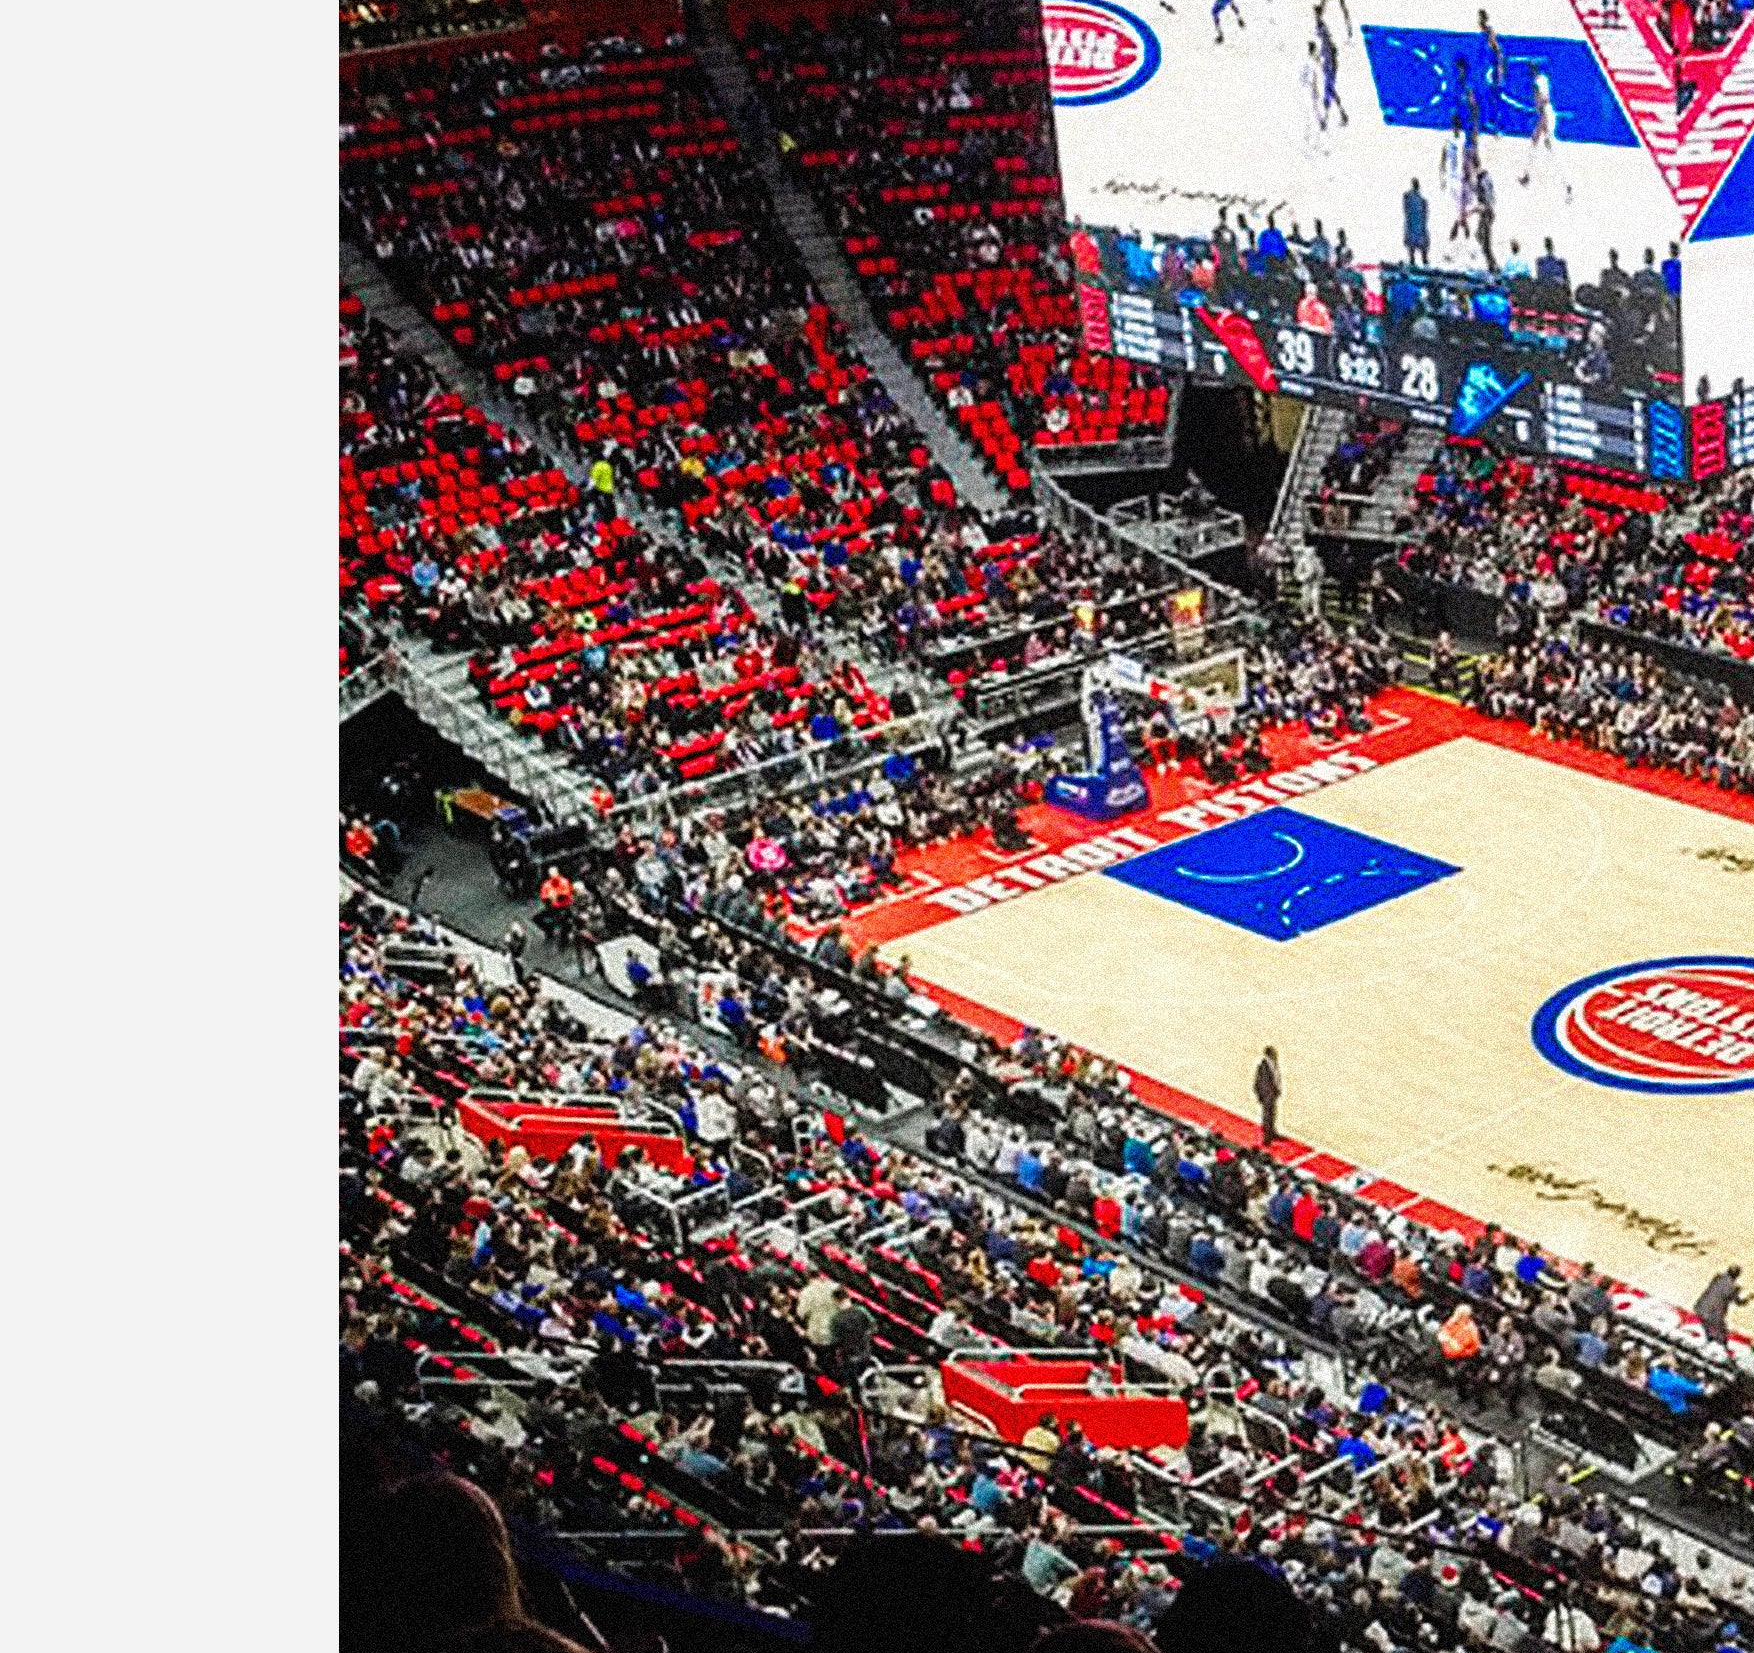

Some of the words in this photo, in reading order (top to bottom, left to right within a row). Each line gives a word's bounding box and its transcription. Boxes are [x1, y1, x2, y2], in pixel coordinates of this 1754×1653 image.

[1277, 329, 1315, 374] 39
[1401, 354, 1439, 402] 28
[927, 827, 1158, 913] DETROIT
[1158, 750, 1377, 831] PISTONS
